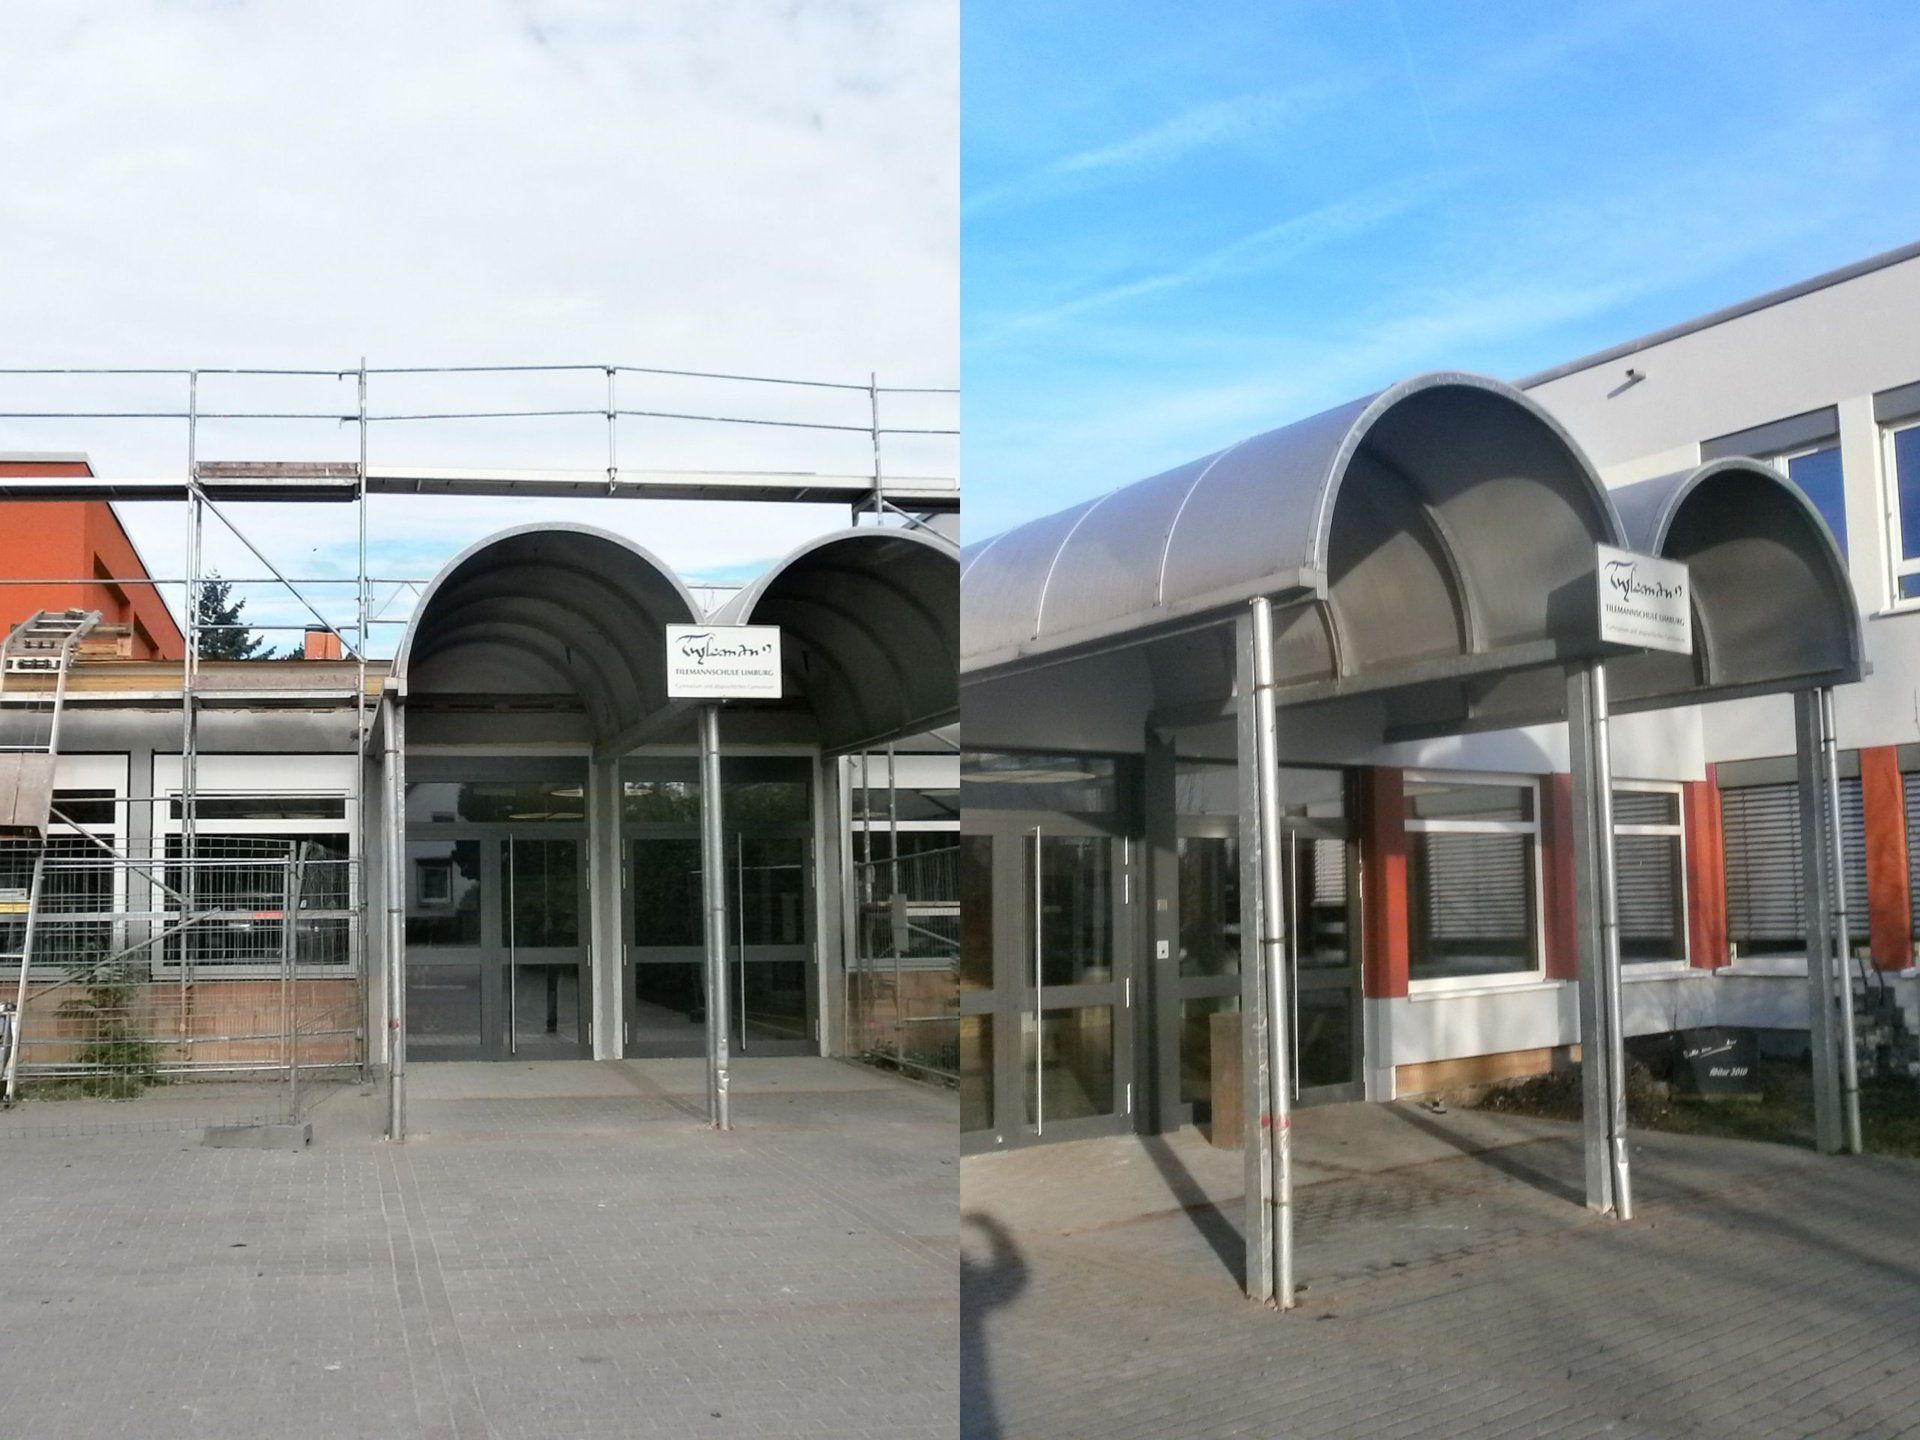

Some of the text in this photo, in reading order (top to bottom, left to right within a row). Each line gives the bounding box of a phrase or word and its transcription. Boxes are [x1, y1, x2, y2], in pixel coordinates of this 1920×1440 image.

[1606, 604, 1685, 627] TILEMANNSCHULE LIMBURG
[675, 668, 774, 677] TILEMANNSCHULE LIMBURG
